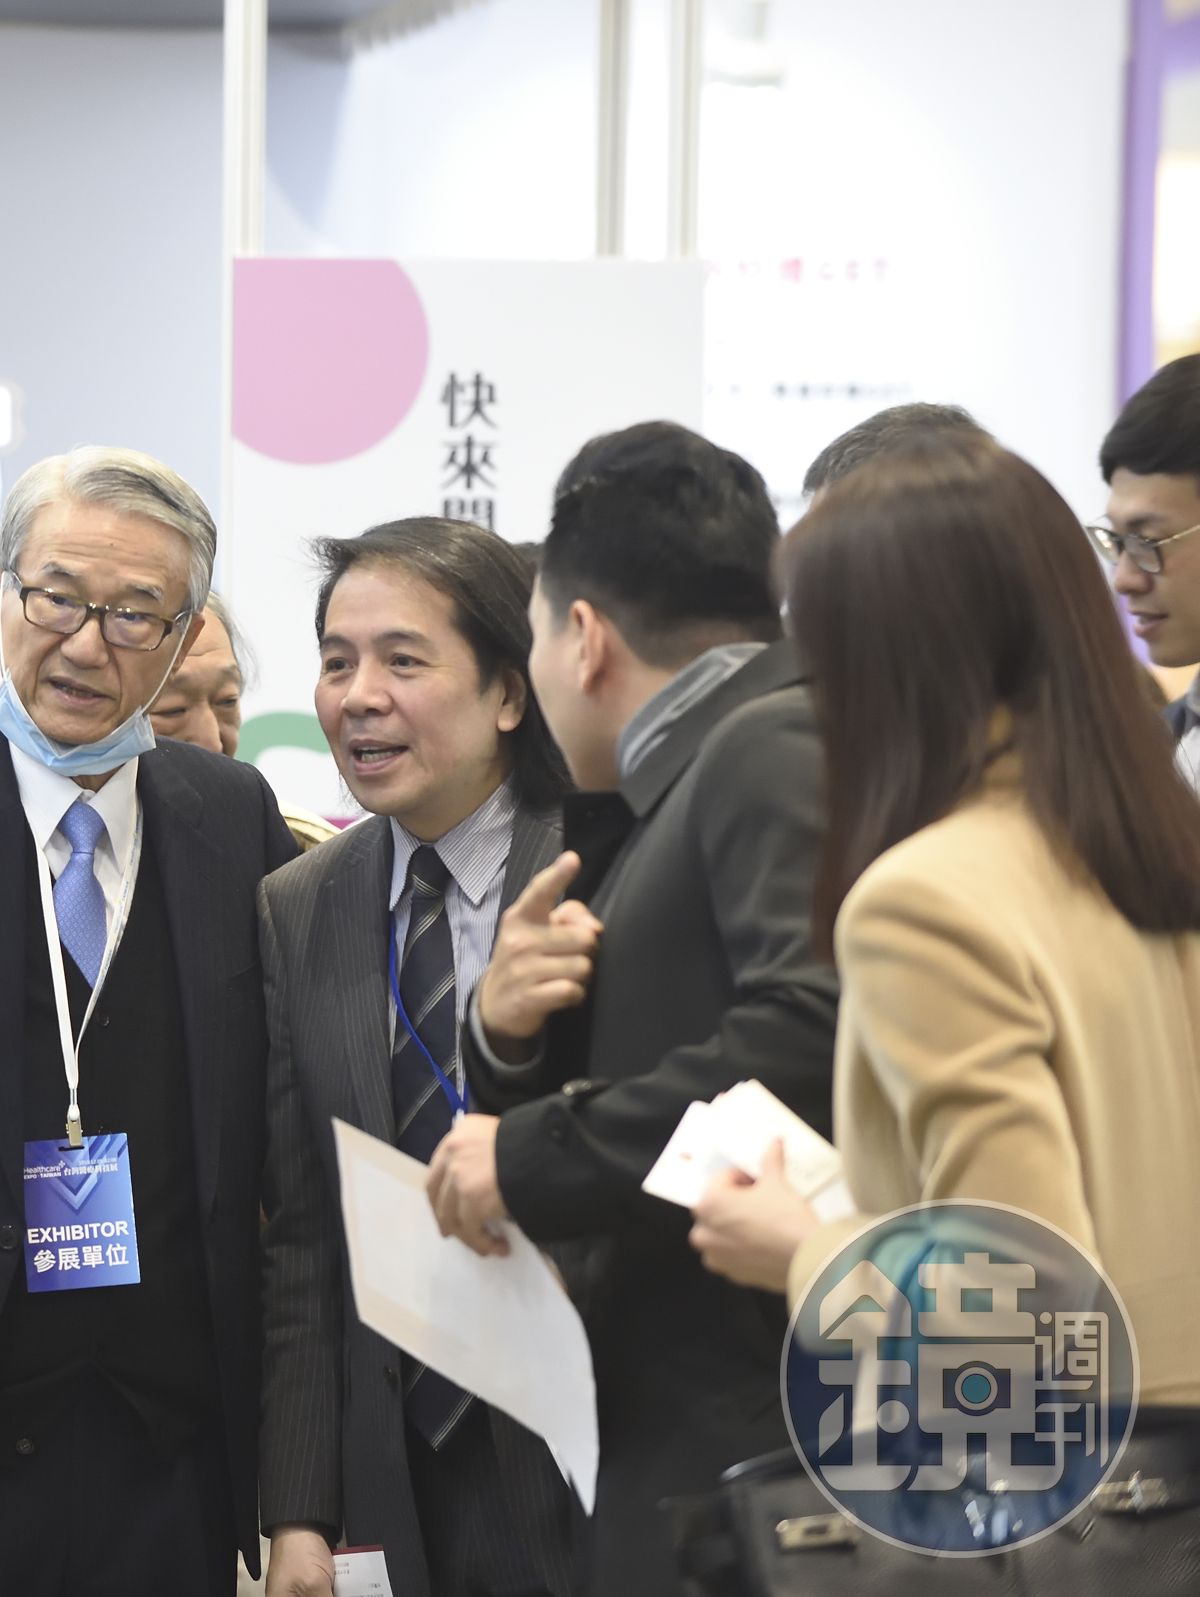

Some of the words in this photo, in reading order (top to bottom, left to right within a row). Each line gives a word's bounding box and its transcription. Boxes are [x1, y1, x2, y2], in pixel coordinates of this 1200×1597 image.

[27, 1220, 129, 1244] EXHIBITOR
[33, 1243, 129, 1273] 參展單位
